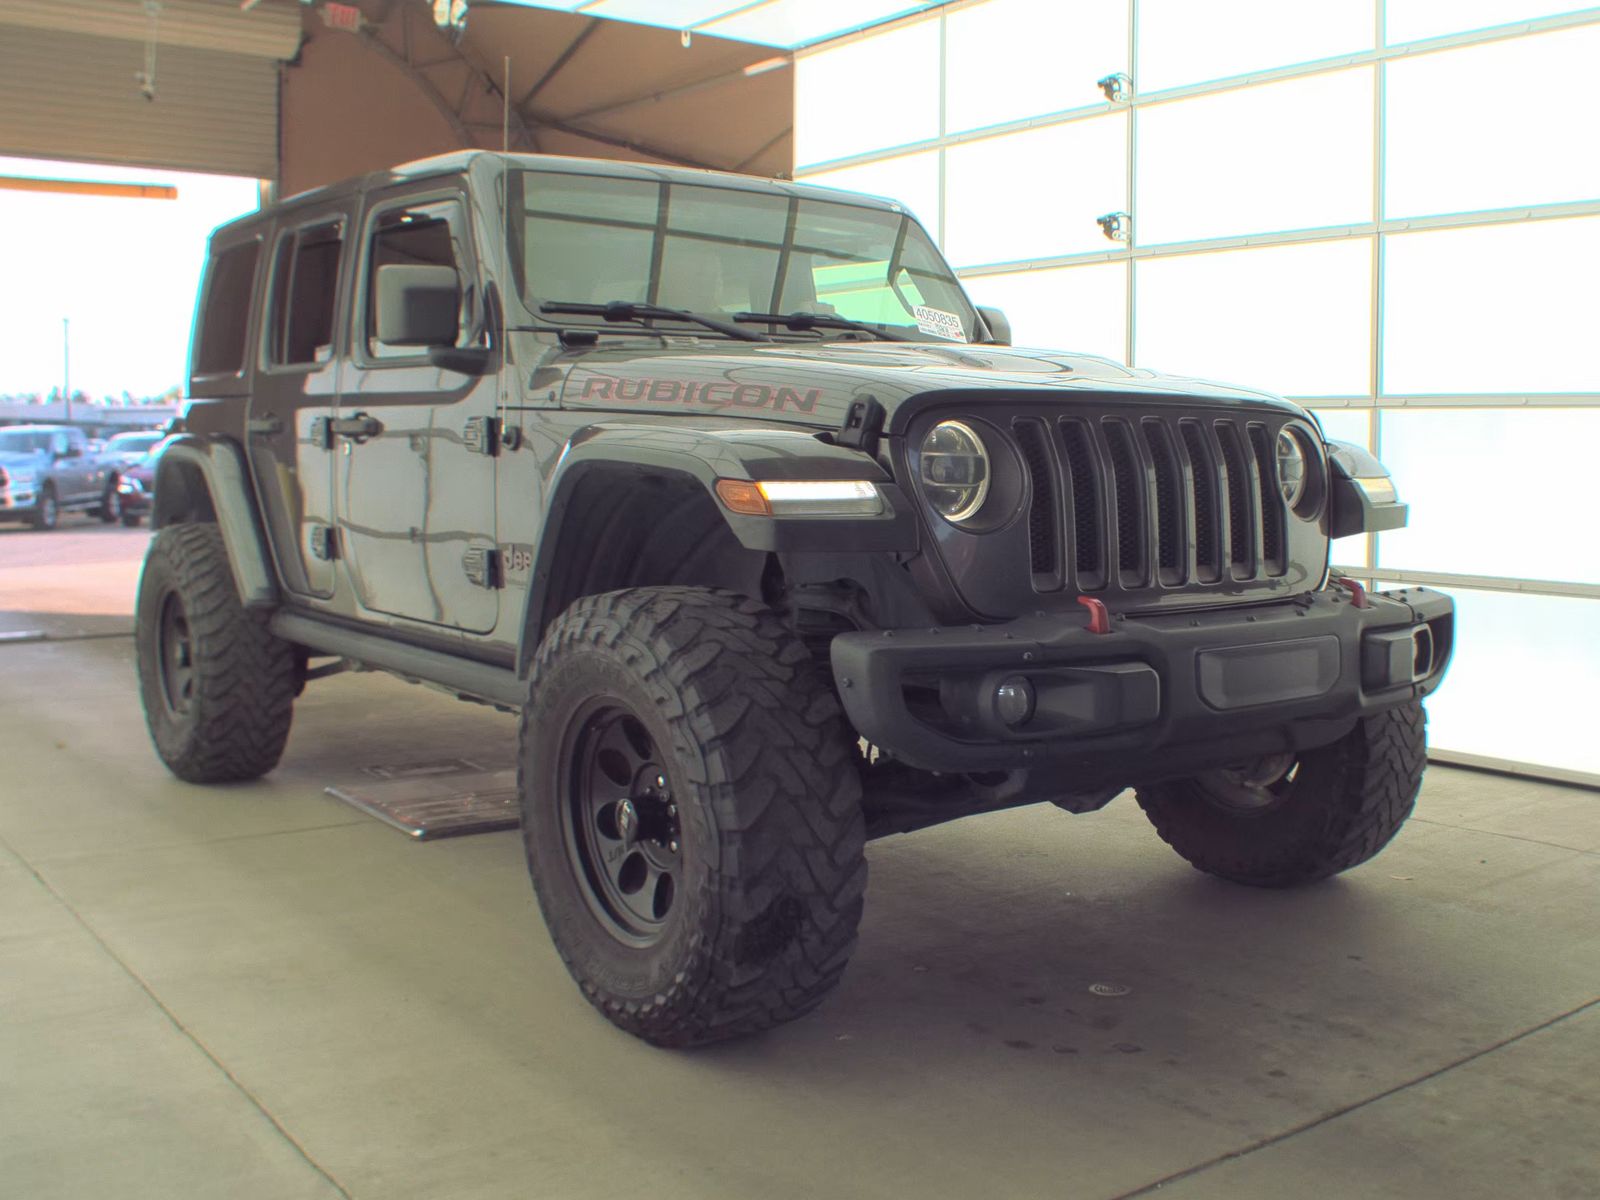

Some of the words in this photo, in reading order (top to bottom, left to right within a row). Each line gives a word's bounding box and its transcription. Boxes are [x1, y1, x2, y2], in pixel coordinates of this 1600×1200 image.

[916, 308, 959, 327] 4050835
[581, 375, 824, 415] RUBICON
[503, 544, 533, 571] Jee
